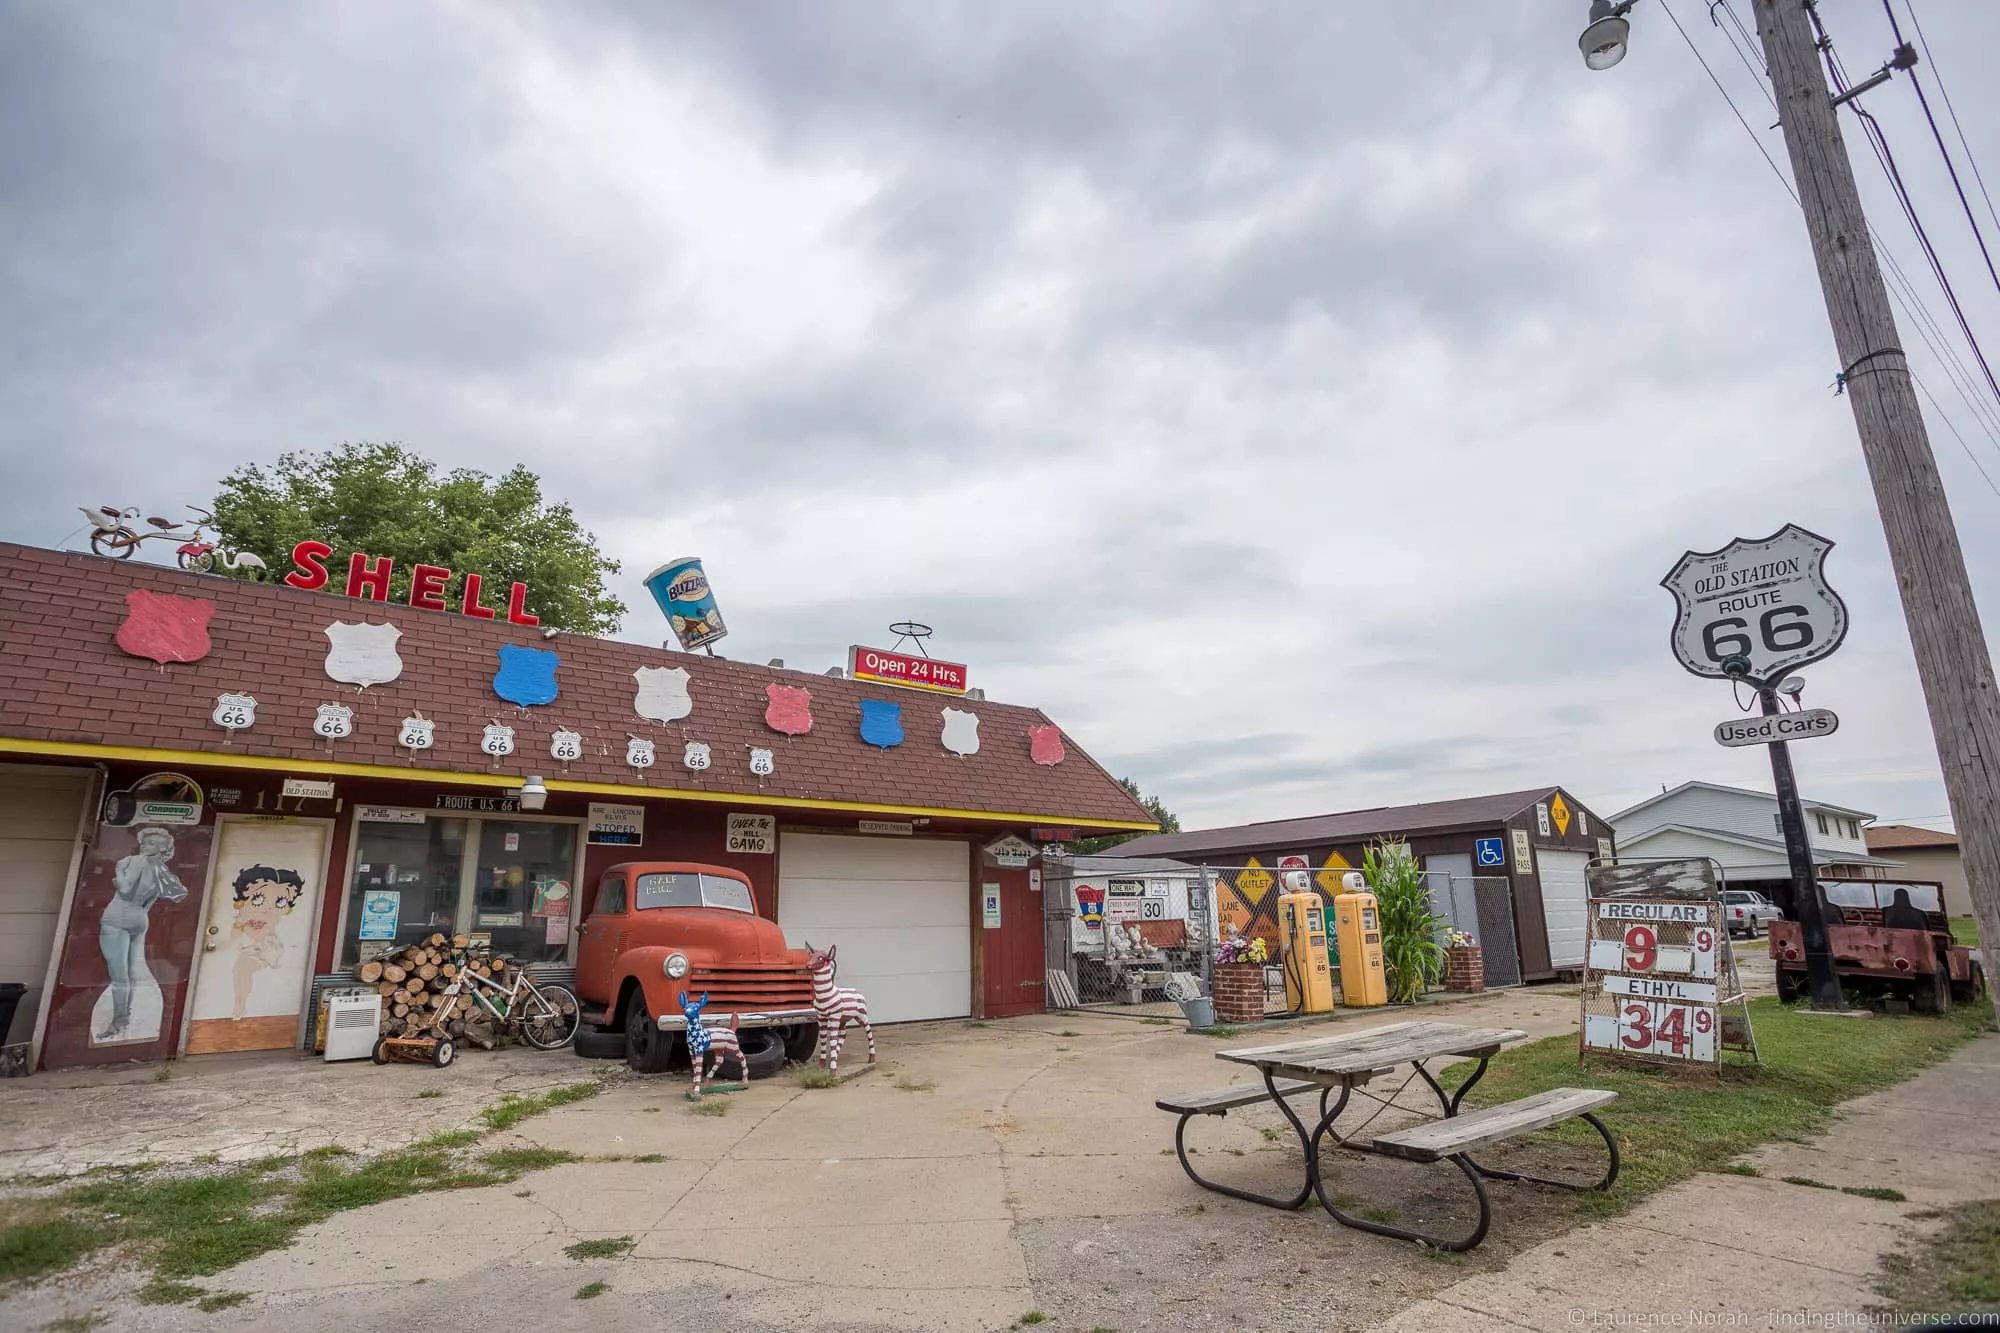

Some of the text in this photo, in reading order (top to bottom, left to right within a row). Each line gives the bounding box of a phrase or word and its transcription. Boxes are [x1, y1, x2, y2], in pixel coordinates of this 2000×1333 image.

[1711, 562, 1729, 574] THE
[1695, 558, 1800, 594] OLD STATION
[284, 541, 540, 626] SHELL
[1718, 589, 1783, 614] ROUTE
[1702, 604, 1814, 663] 66
[865, 653, 960, 683] Open 24 Hrs.
[221, 711, 246, 725] 66
[321, 722, 344, 734] 66
[1720, 716, 1828, 742] Used Cars
[405, 735, 426, 746] 66
[488, 740, 507, 752] 66
[557, 746, 575, 757] 66
[632, 754, 649, 764] 66
[689, 756, 705, 767] 66
[754, 762, 769, 772] 66
[287, 787, 330, 797] OLD STATION
[444, 796, 473, 809] ROUTE
[501, 801, 513, 812] 66
[612, 808, 642, 816] LINCOLN
[595, 823, 637, 833] STOPED
[731, 818, 755, 829] OVER
[1541, 821, 1548, 832] 10
[599, 835, 629, 843] HERE
[743, 830, 760, 838] HILL
[730, 837, 766, 850] GANG
[1517, 846, 1527, 857] NOT
[1517, 860, 1530, 870] PASS
[1248, 869, 1259, 877] NO
[1240, 879, 1269, 889] OUTLET
[1144, 902, 1161, 918] 30
[1221, 902, 1239, 911] LANE
[1217, 913, 1233, 923] OAD
[1608, 904, 1698, 921] REGULAR
[1625, 926, 1713, 971] 9 9
[1628, 979, 1687, 998] ETHYL
[1621, 1004, 1712, 1054] 34 9
